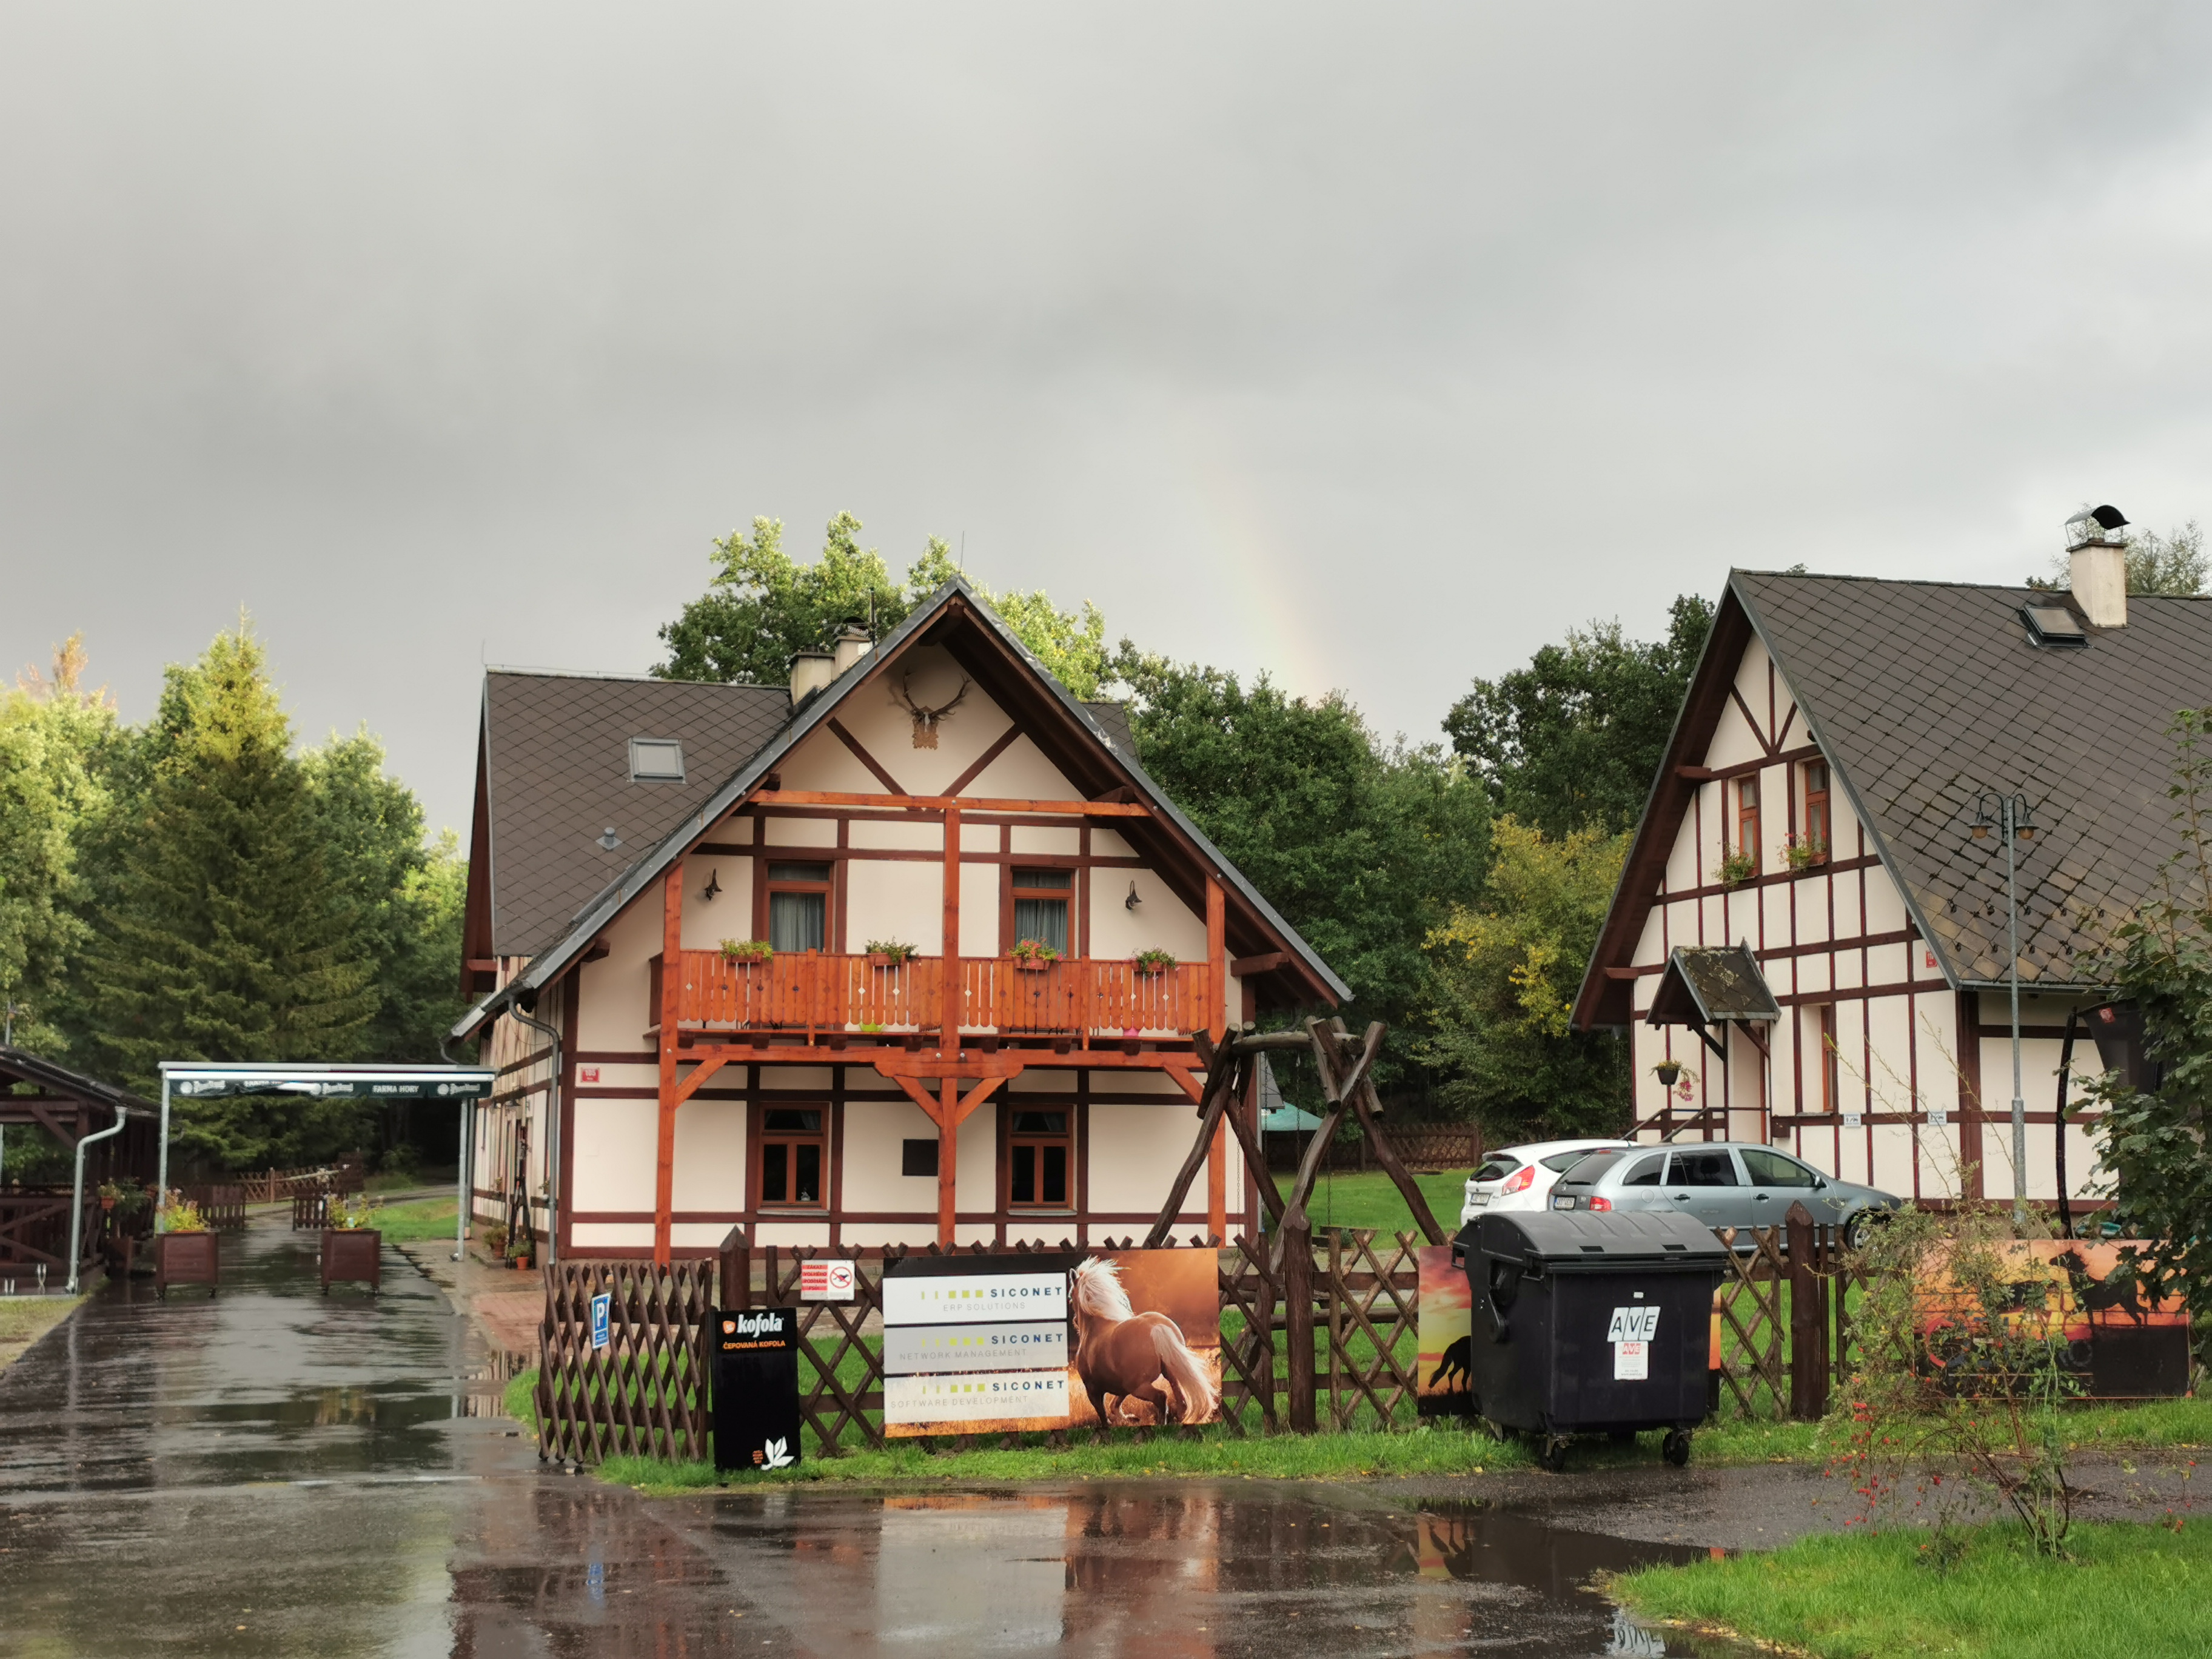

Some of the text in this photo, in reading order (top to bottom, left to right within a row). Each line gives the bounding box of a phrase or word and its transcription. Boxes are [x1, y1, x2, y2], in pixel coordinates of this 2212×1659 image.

[399, 1085, 419, 1093] HORY
[990, 1287, 1062, 1298] SICONET
[967, 1302, 1026, 1310] SOLUTIONS
[597, 1302, 605, 1327] P
[737, 1312, 783, 1338] kofola
[1611, 1315, 1656, 1333] AVE
[723, 1340, 758, 1350] ČEPOVANÁ
[991, 1333, 1063, 1345] SICONET
[900, 1349, 1027, 1360] NETWORK MANAGEMENT
[993, 1379, 1065, 1392] SICONET
[891, 1396, 1028, 1409] SOFTWARE DEVELOPMENT
